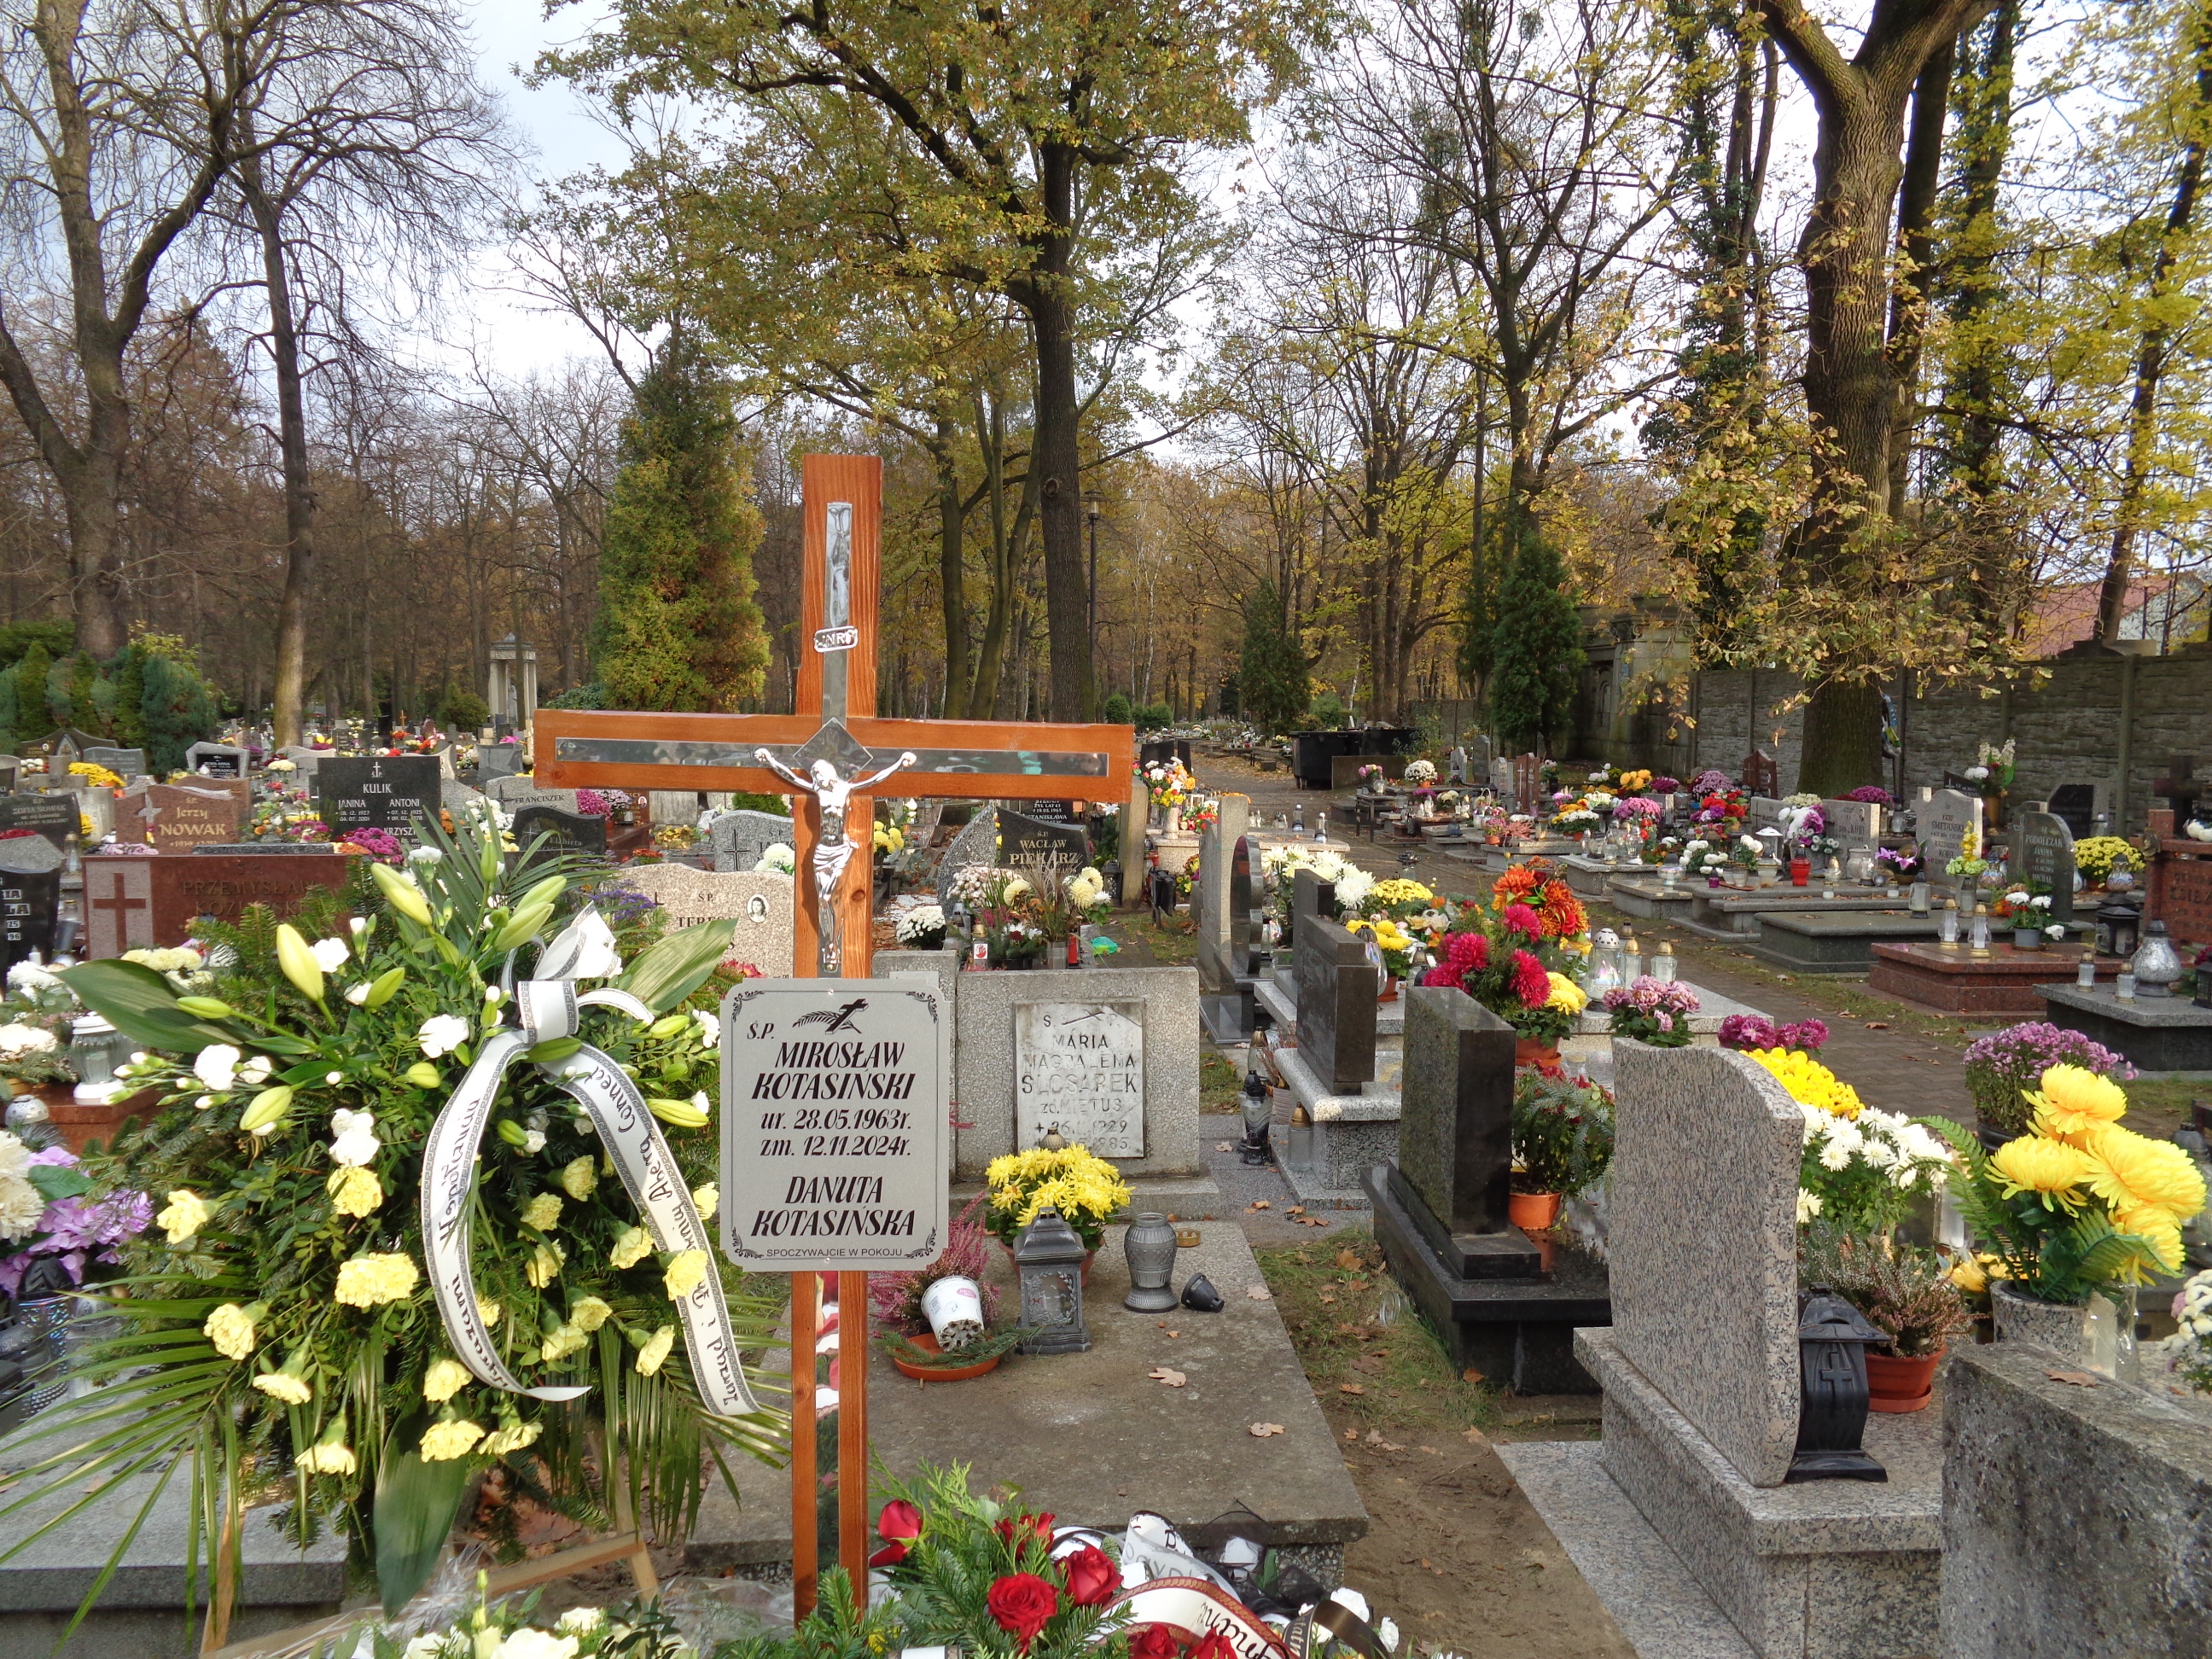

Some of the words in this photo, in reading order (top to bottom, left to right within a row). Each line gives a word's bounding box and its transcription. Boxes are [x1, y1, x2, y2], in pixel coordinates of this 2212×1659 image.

[363, 783, 393, 794] KULIK
[338, 799, 366, 810] JANINA
[389, 798, 420, 807] ANTONI
[515, 795, 565, 804] FRANCISZEK
[176, 806, 208, 819] Jerzy
[159, 824, 226, 835] NOWAK
[384, 827, 427, 835] KRZYSZT
[1020, 839, 1068, 849] WACŁAW
[1052, 1034, 1109, 1050] MARIA
[774, 1041, 905, 1068] MIROSŁAW
[1022, 1053, 1136, 1069] MAGDALENA
[751, 1068, 917, 1100] KOTASIŃSKI
[584, 1065, 637, 1134] Connect
[760, 1111, 787, 1130] ur.
[793, 1109, 911, 1130] 28.05.1963r.
[760, 1138, 795, 1156] zm.
[803, 1135, 911, 1156] 12.11.2024r.
[784, 1176, 884, 1204] DANUTA
[750, 1206, 916, 1237] KOTASIŃSKA
[766, 1249, 846, 1257] SPOCZYWAJCIE
[861, 1248, 903, 1256] POKOJU
